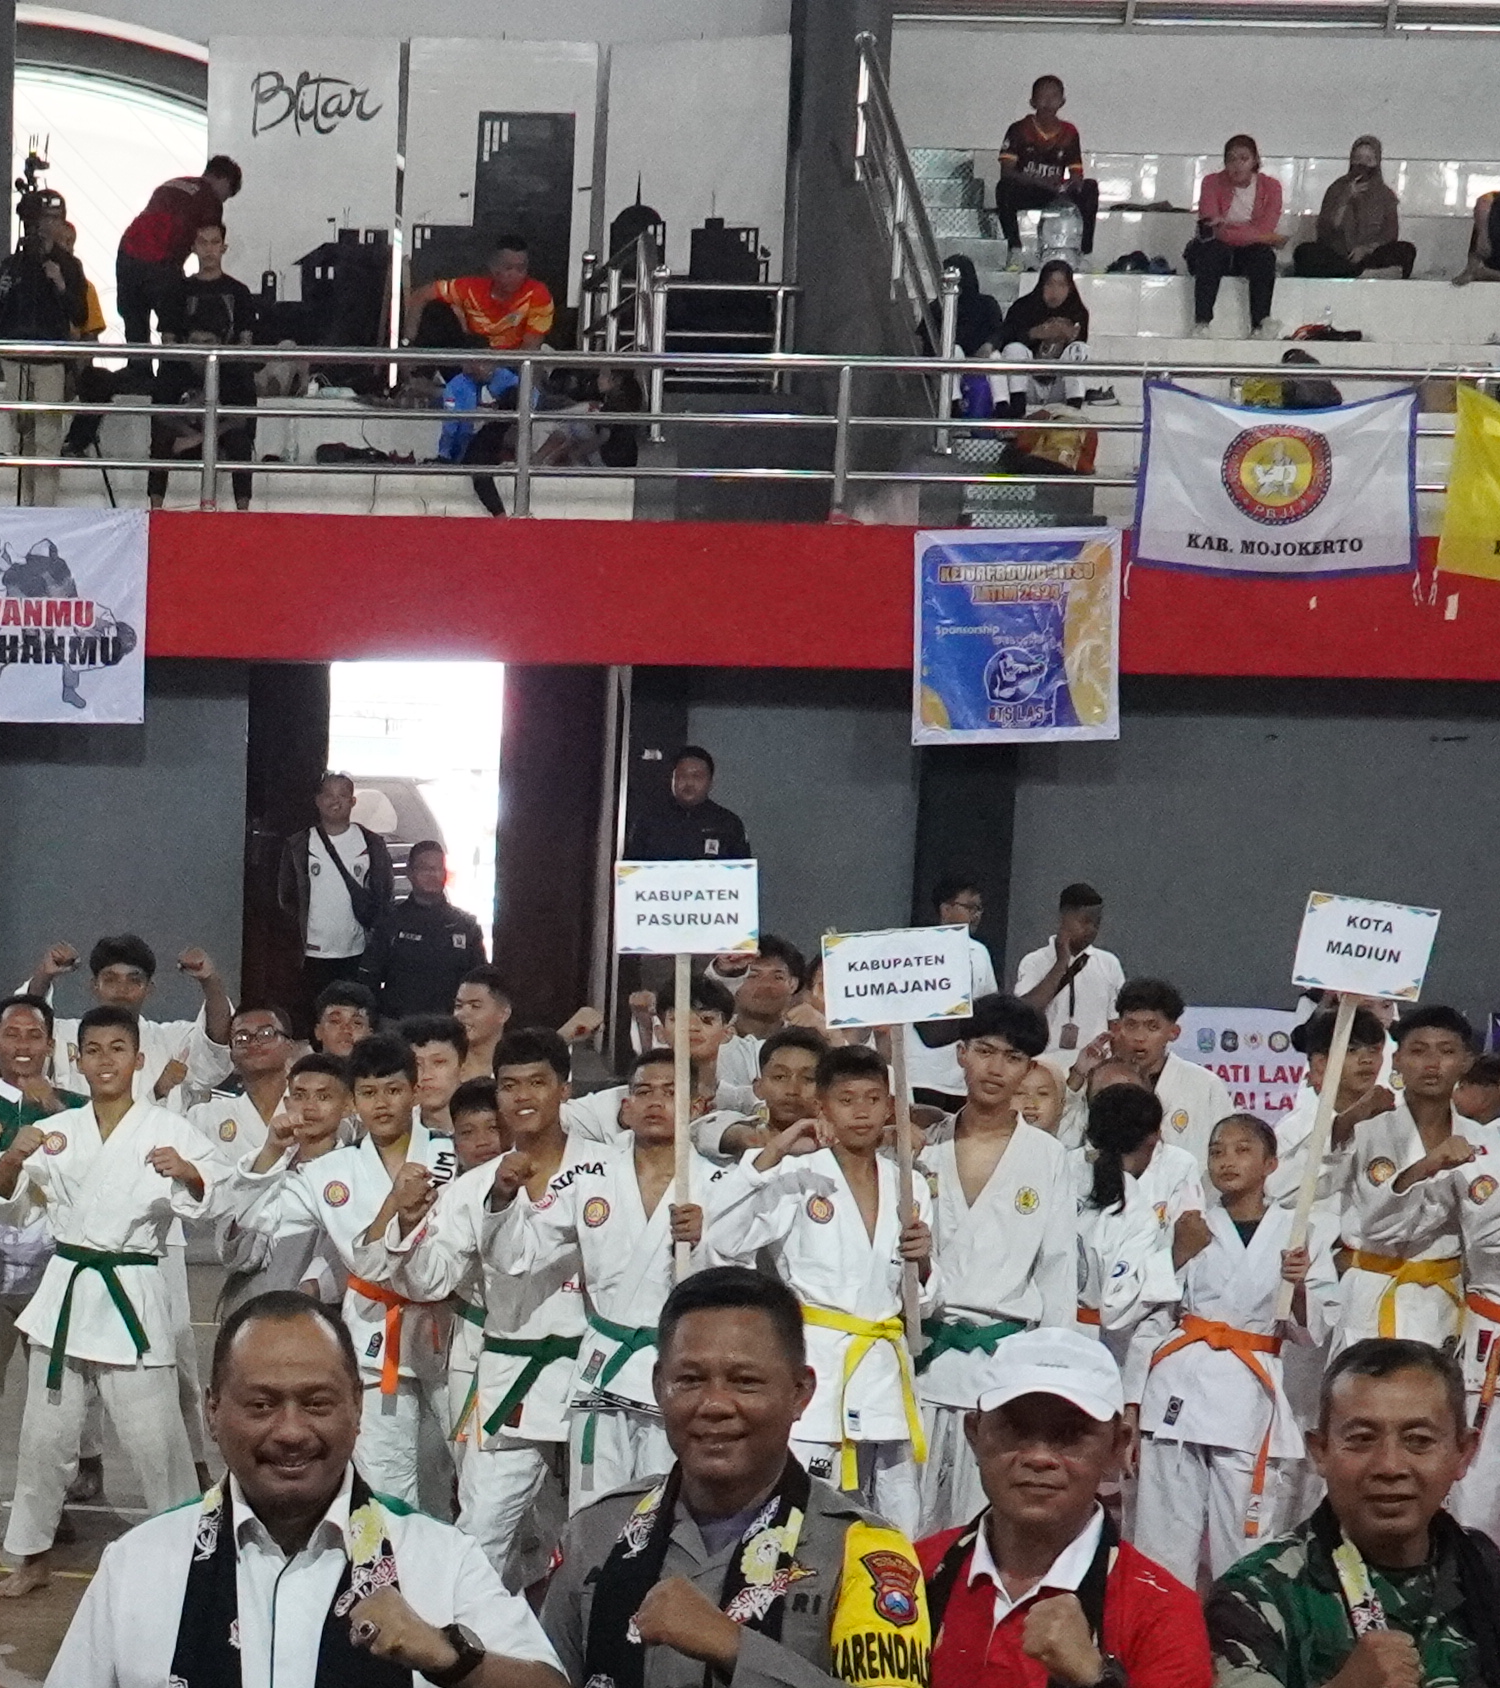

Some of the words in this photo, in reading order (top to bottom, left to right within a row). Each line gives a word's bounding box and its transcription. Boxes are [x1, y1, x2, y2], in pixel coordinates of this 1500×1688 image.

[1186, 533, 1234, 553] KAB.
[1240, 538, 1364, 557] MOJOKERTO
[935, 622, 1000, 636] Sponsorship
[635, 888, 740, 903] KABUPATEN
[636, 912, 740, 926] PASURUAN
[1346, 914, 1395, 934] KOTA
[1326, 939, 1402, 965] MADIUN
[847, 954, 947, 973] KABUPATEN
[844, 977, 953, 998] LUMAJANG
